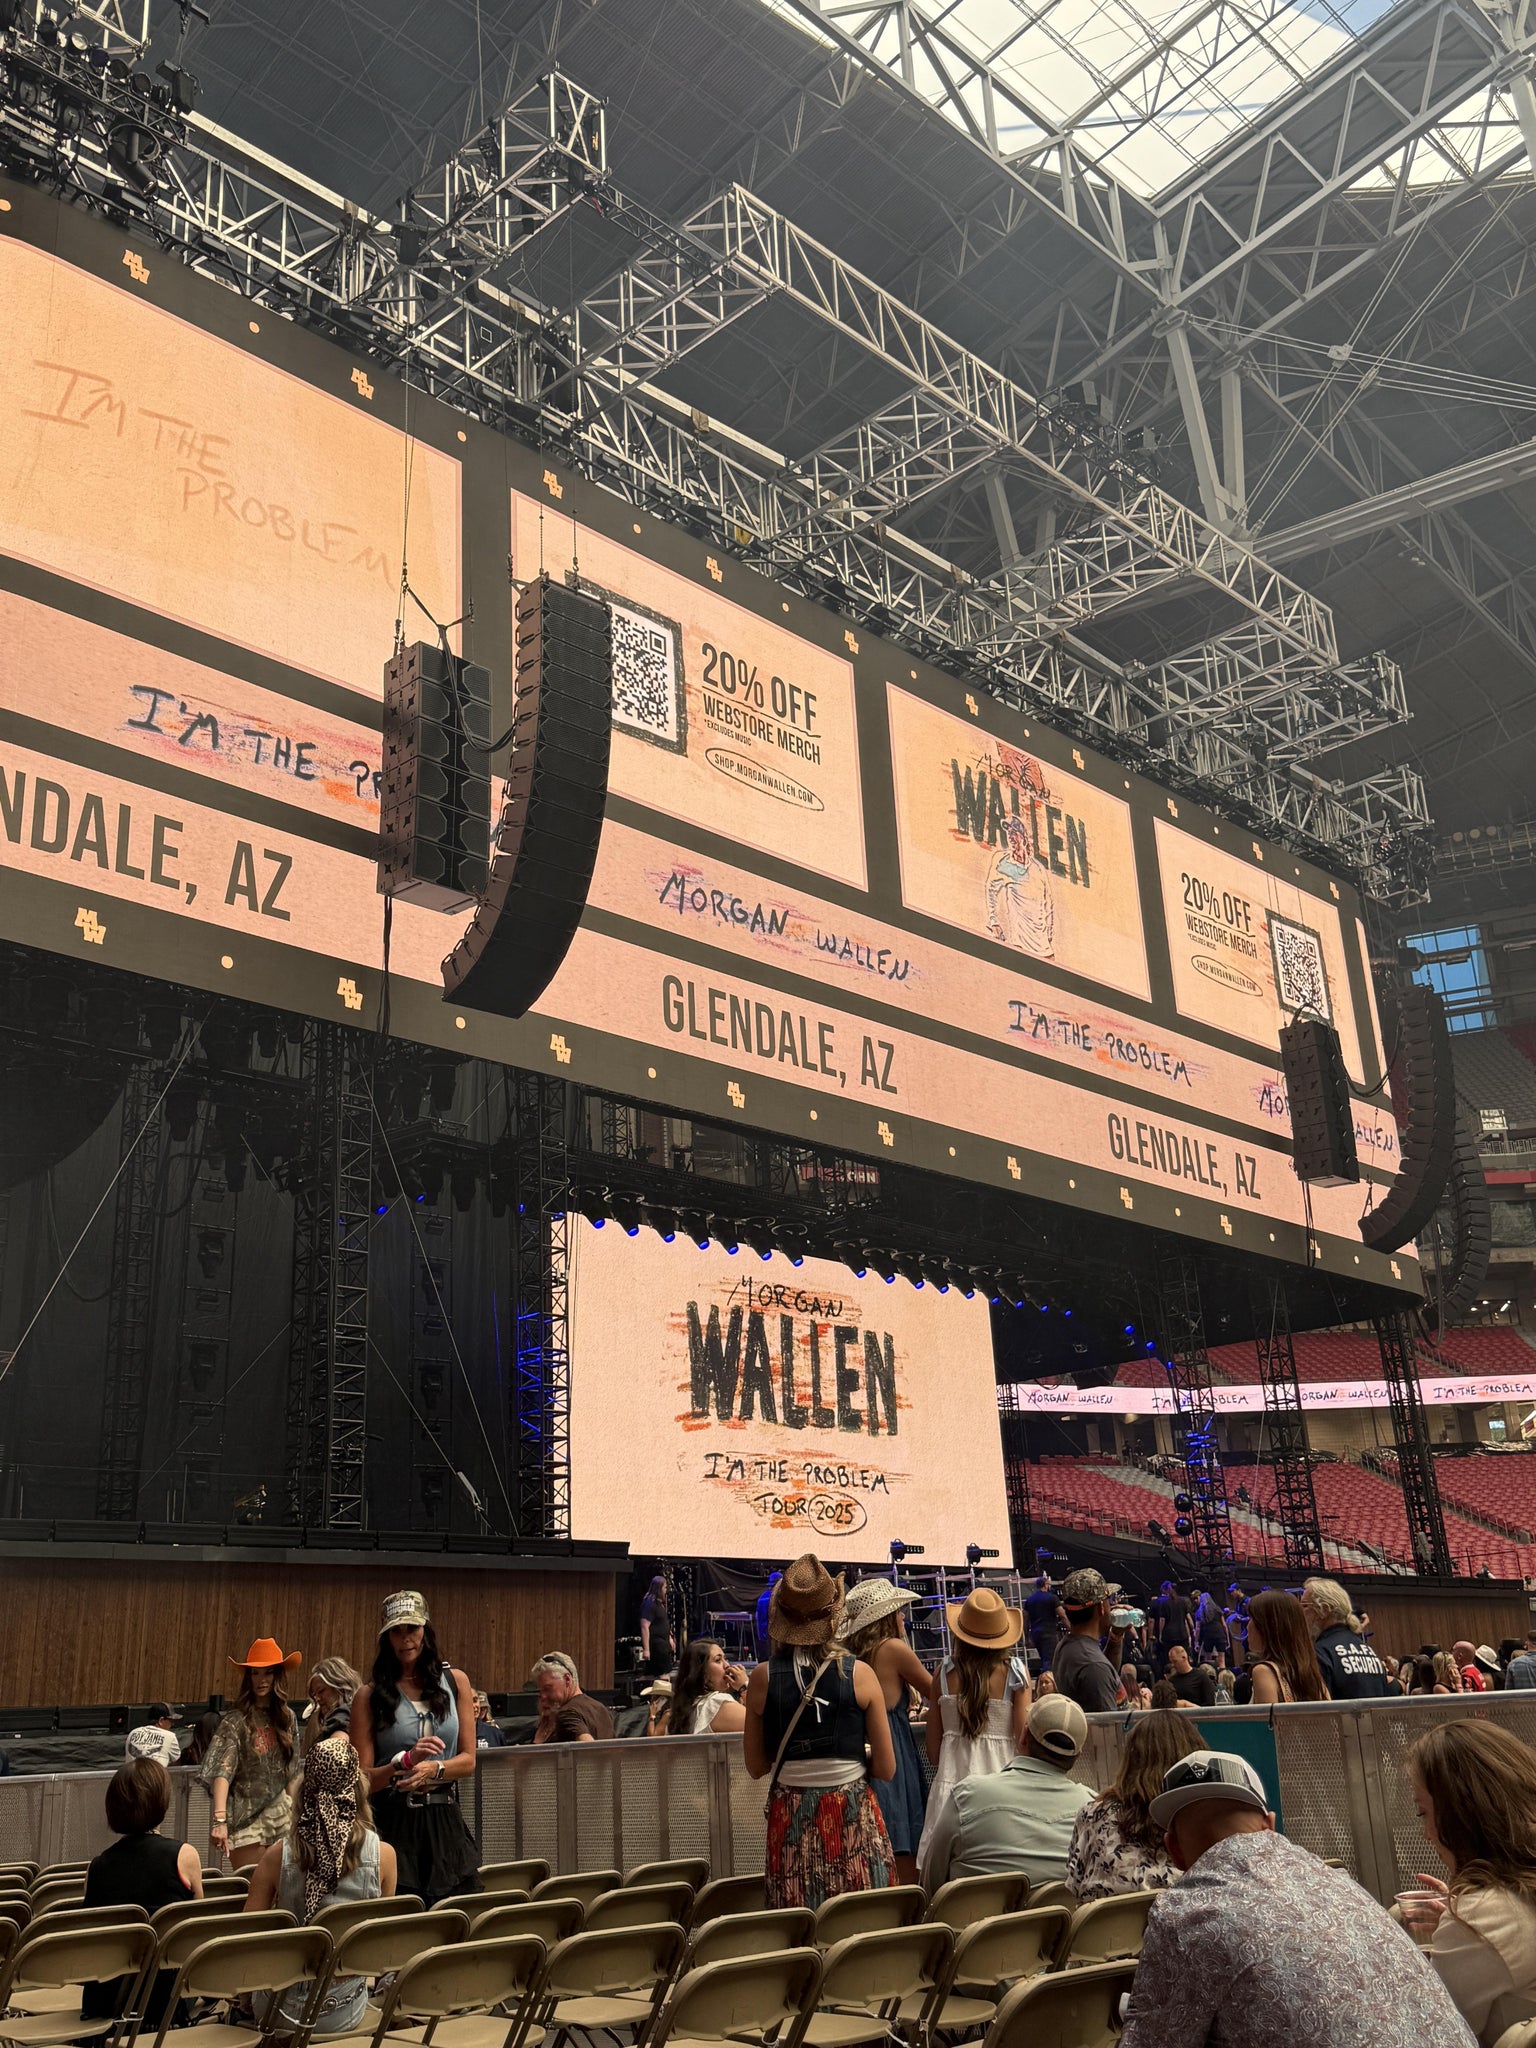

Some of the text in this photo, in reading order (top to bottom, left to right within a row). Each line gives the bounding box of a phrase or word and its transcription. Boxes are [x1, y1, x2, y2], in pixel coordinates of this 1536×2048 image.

[20, 359, 230, 477] I'M THE
[176, 467, 396, 593] PROBLEM
[702, 642, 817, 731] 20% OFF
[127, 684, 219, 750] I'M
[243, 729, 317, 781] THE
[703, 693, 821, 765] WEBSTORE MERCH
[714, 753, 813, 805] SHOP.MORGANWALLEN.COM
[0, 766, 293, 922] NDALE, AZ
[659, 872, 910, 981] MORGAN WALLEN
[1181, 872, 1252, 933] 20% OFF
[1186, 912, 1229, 947] WEBSTORE
[1229, 932, 1258, 960] MERCH
[662, 974, 898, 1095] GLENDALE, AZ
[1008, 1000, 1192, 1088] I'M THE PROBLEM
[1107, 1113, 1262, 1200] GLENDALE, AZ
[1355, 1122, 1394, 1152] ALLEN
[727, 1275, 843, 1317] MORGAN
[686, 1300, 899, 1437] WALLEN
[1028, 1393, 1113, 1405] MORGAN WALLEN
[1301, 1389, 1338, 1402] ORGAN
[1458, 1385, 1477, 1397] THE
[1484, 1382, 1533, 1395] PROBLEM
[703, 1453, 890, 1495] I'M THE PROBLEM
[754, 1492, 854, 1524] TOUR 2025
[1340, 1656, 1384, 1675] SECURIT
